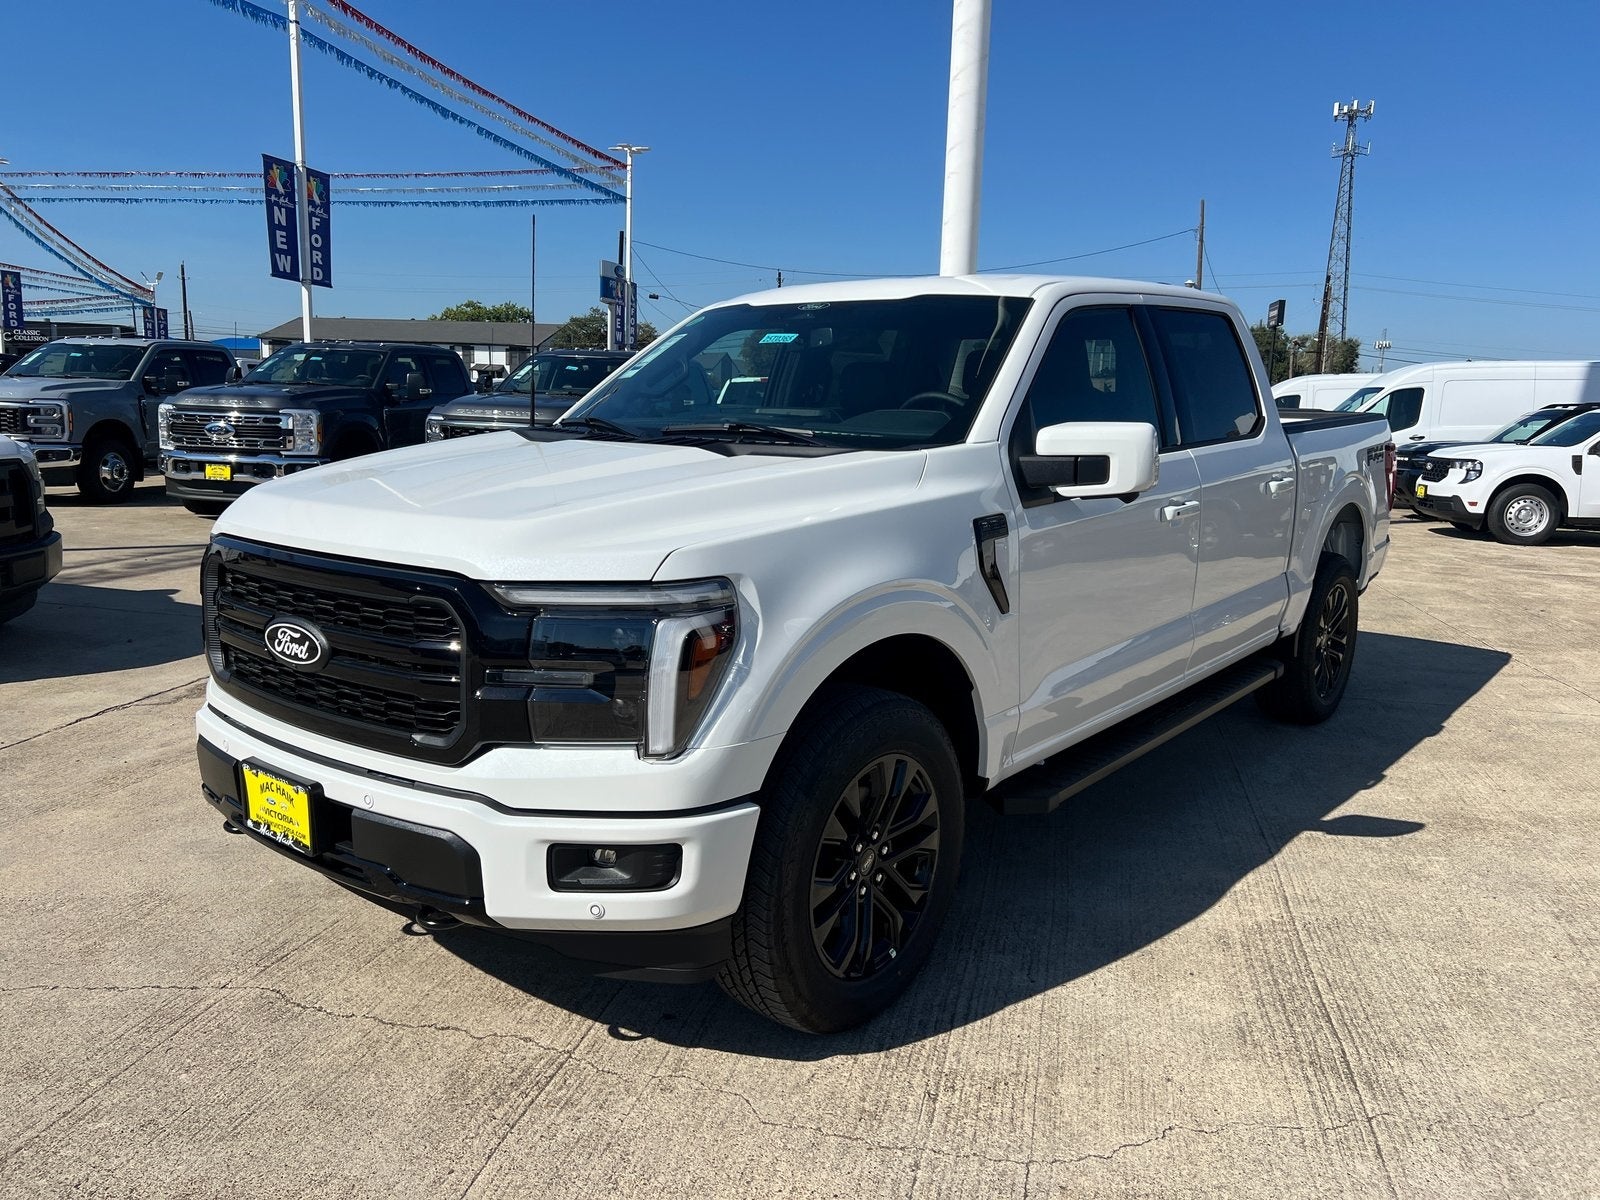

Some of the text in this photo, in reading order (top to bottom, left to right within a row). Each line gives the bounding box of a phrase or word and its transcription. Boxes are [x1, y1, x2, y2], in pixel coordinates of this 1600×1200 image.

[273, 206, 291, 273] NEW
[311, 216, 323, 281] FORD
[7, 294, 18, 327] FORD
[274, 627, 309, 659] Ford
[276, 784, 296, 808] HAIK
